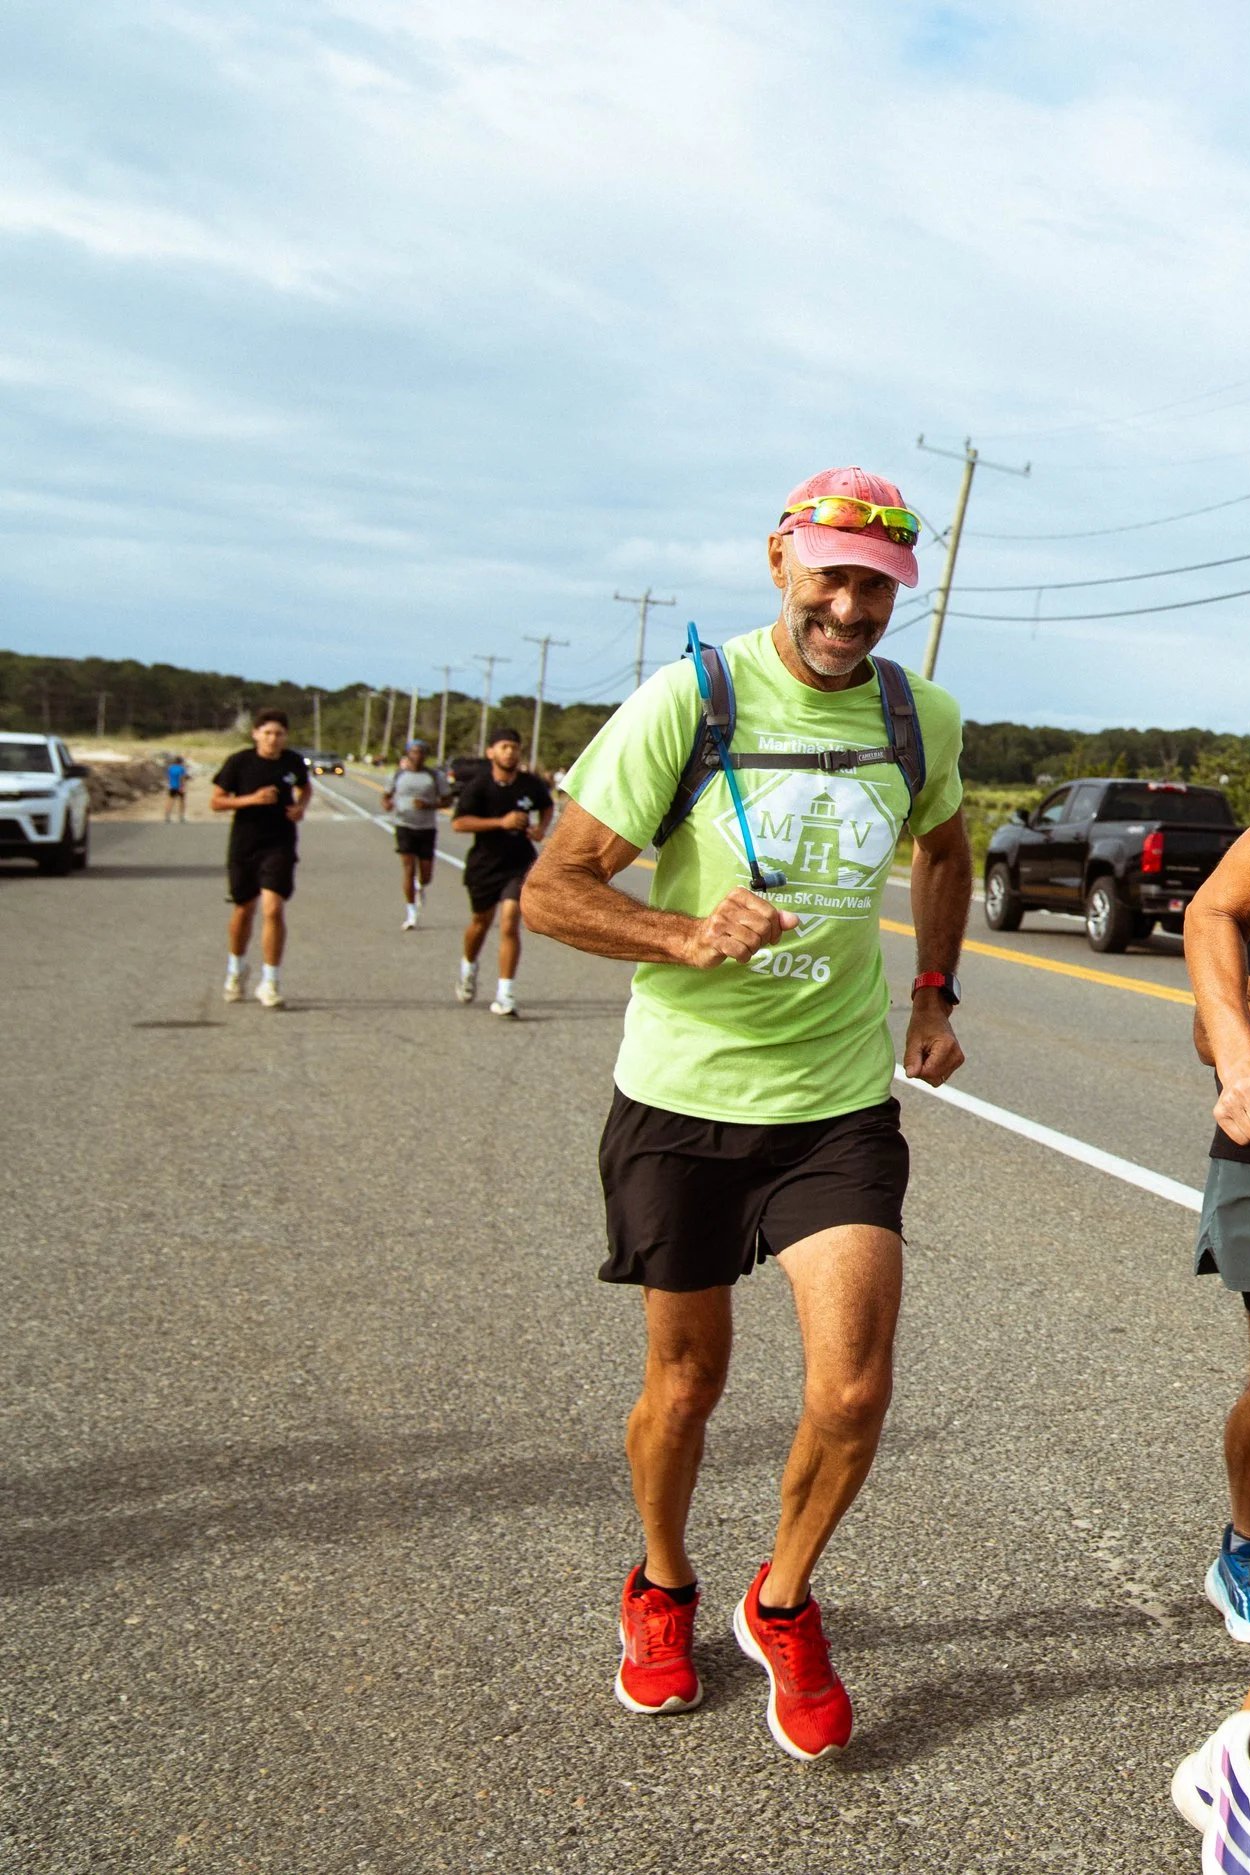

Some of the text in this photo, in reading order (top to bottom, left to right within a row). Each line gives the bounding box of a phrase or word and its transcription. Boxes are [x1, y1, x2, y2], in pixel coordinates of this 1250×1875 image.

[759, 736, 825, 753] Martha's
[757, 811, 872, 848] M V
[799, 841, 833, 873] H
[794, 892, 813, 905] 5K
[814, 894, 872, 908] Run/Walk
[750, 948, 831, 983] 2026
